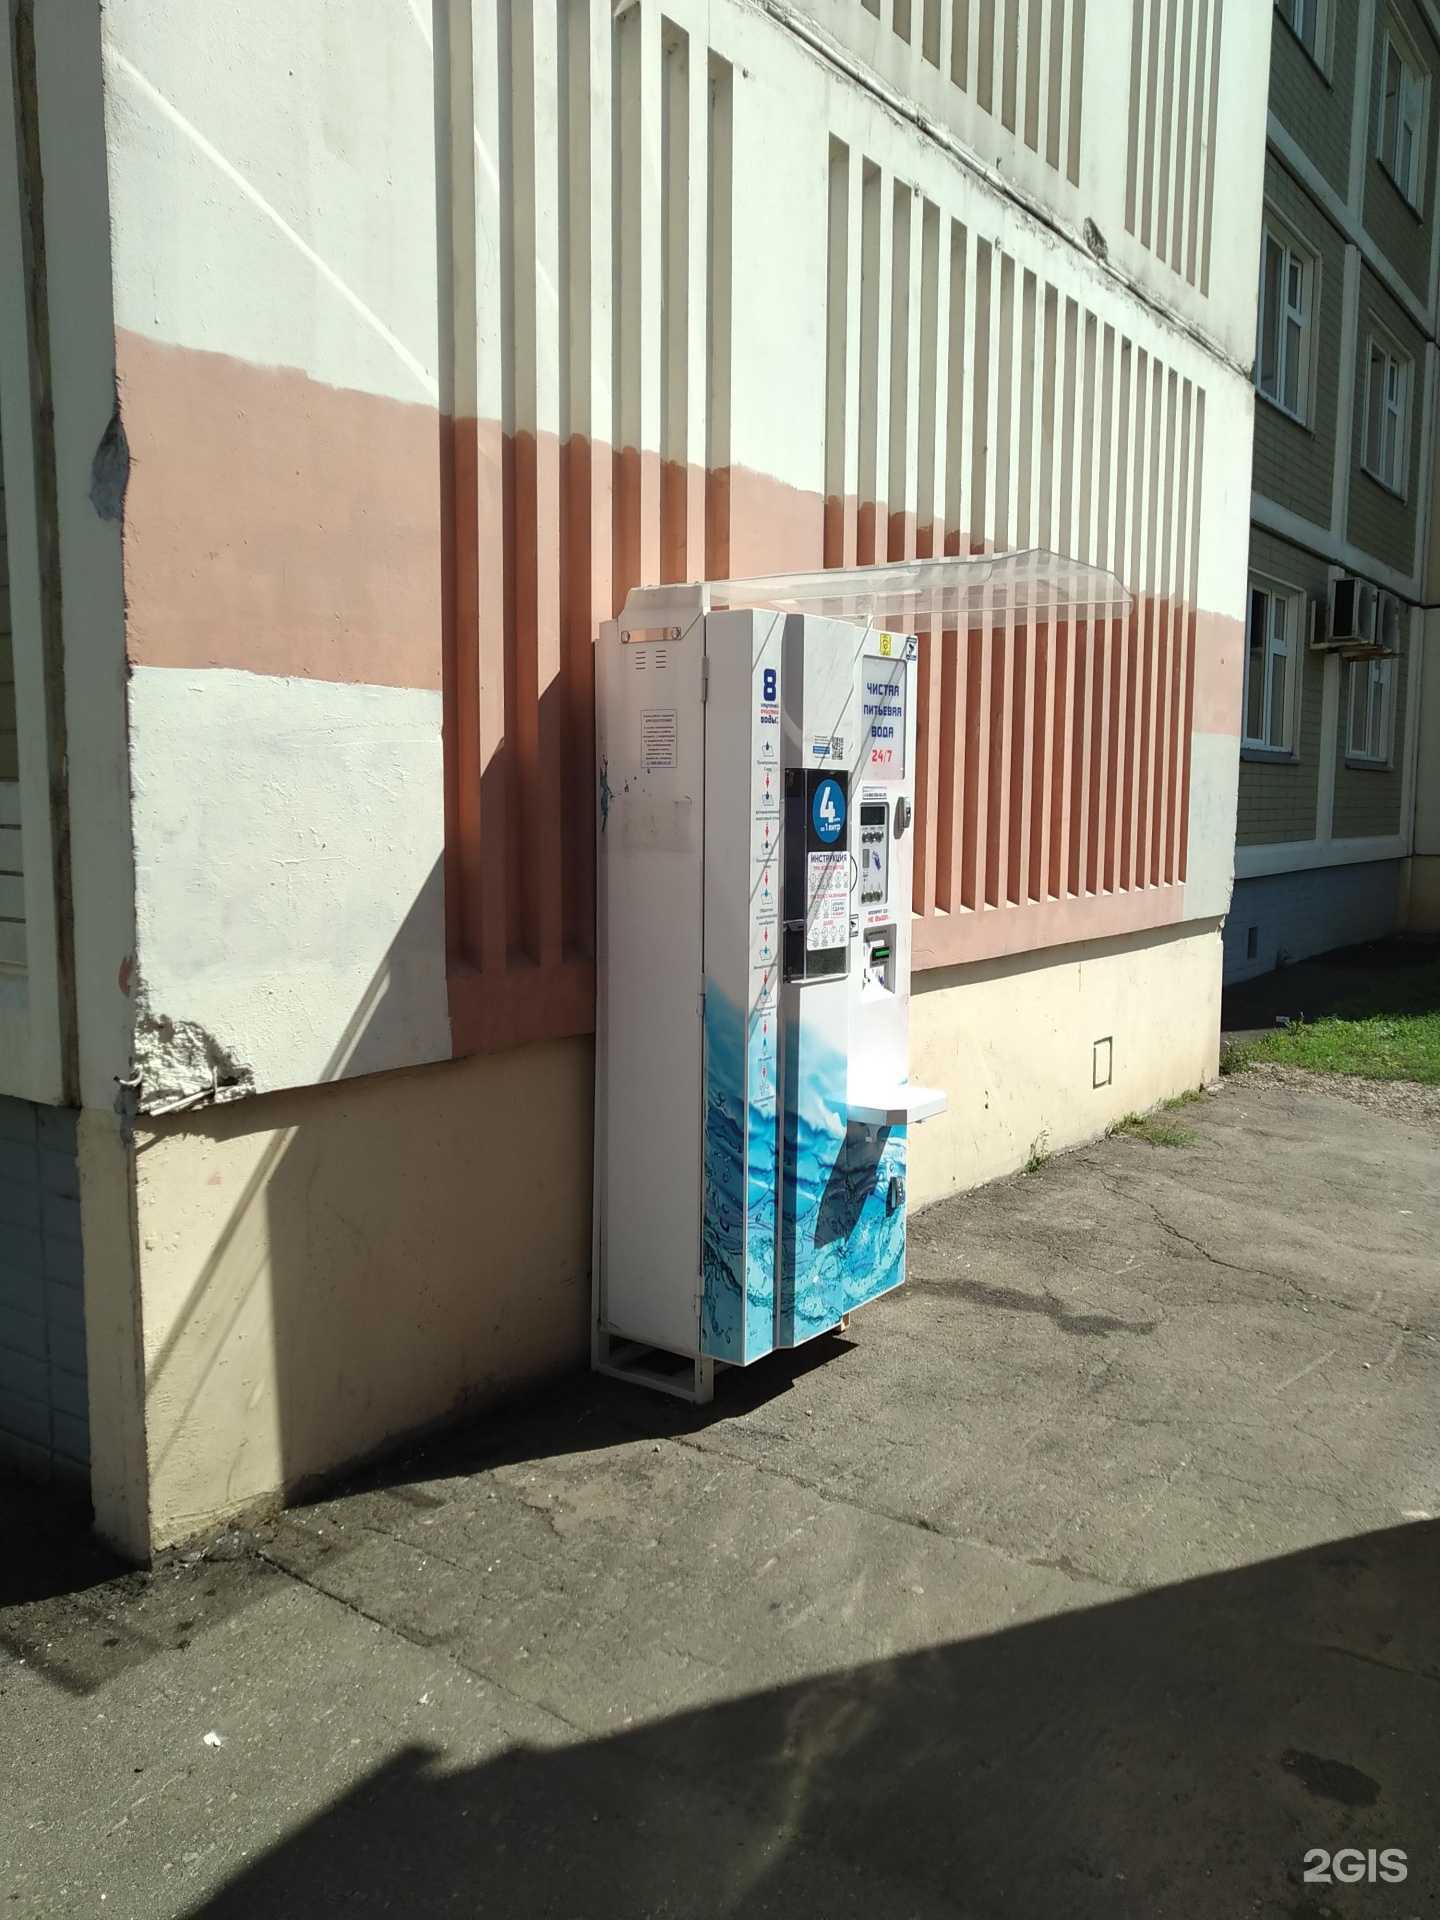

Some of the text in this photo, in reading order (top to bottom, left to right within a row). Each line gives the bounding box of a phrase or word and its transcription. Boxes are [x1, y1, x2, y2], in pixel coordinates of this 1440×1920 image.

[763, 668, 777, 701] 8
[866, 682, 900, 697] ЧИСТАЯ
[863, 704, 902, 717] ПИТЬЕВАЯ
[871, 726, 894, 738] ВОДА
[871, 749, 893, 763] 24/7
[820, 786, 836, 823] 4
